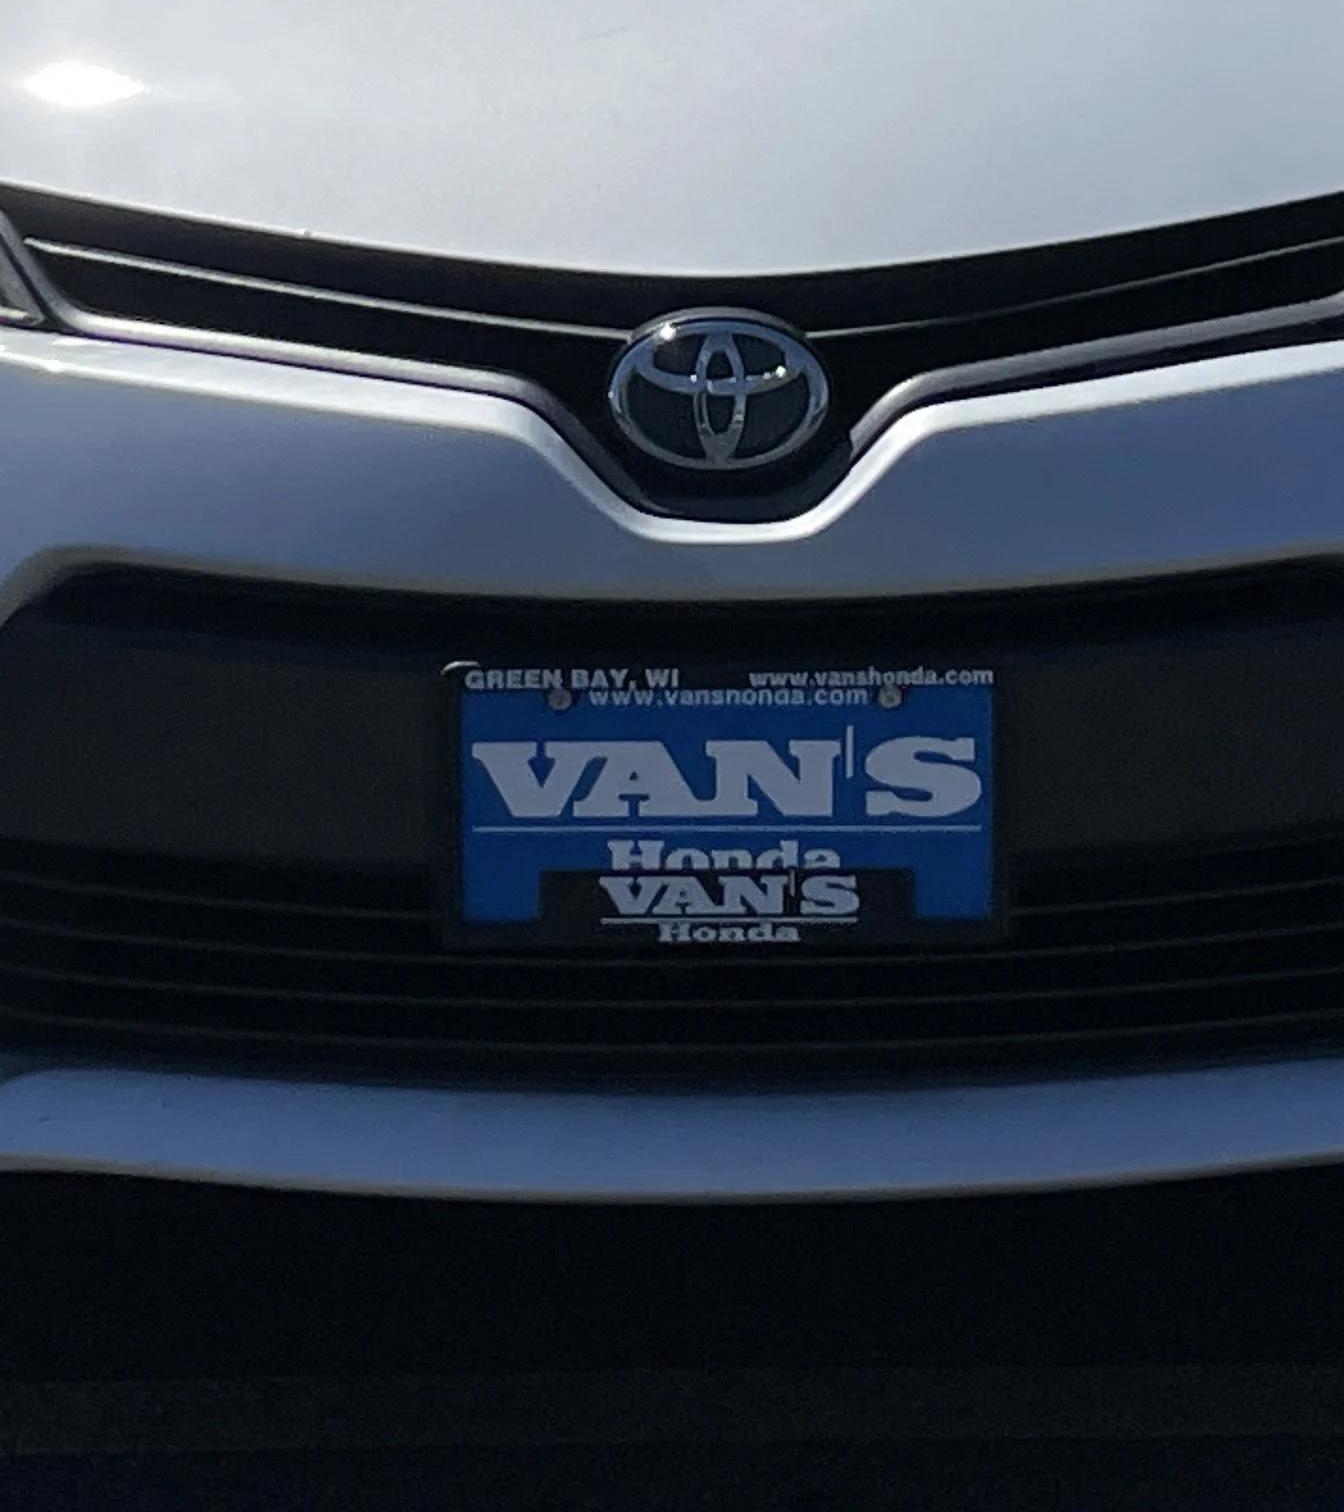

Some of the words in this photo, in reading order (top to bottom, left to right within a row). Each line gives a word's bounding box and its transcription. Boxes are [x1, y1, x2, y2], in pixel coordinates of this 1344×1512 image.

[464, 668, 563, 689] GREEN
[571, 668, 637, 690] BAY,
[645, 668, 680, 689] WI
[749, 665, 994, 688] www.vanshonda.com
[471, 724, 982, 818] VAN'S
[607, 839, 841, 870] Honda
[599, 869, 860, 916] VAN'S
[659, 922, 801, 943] Honda
